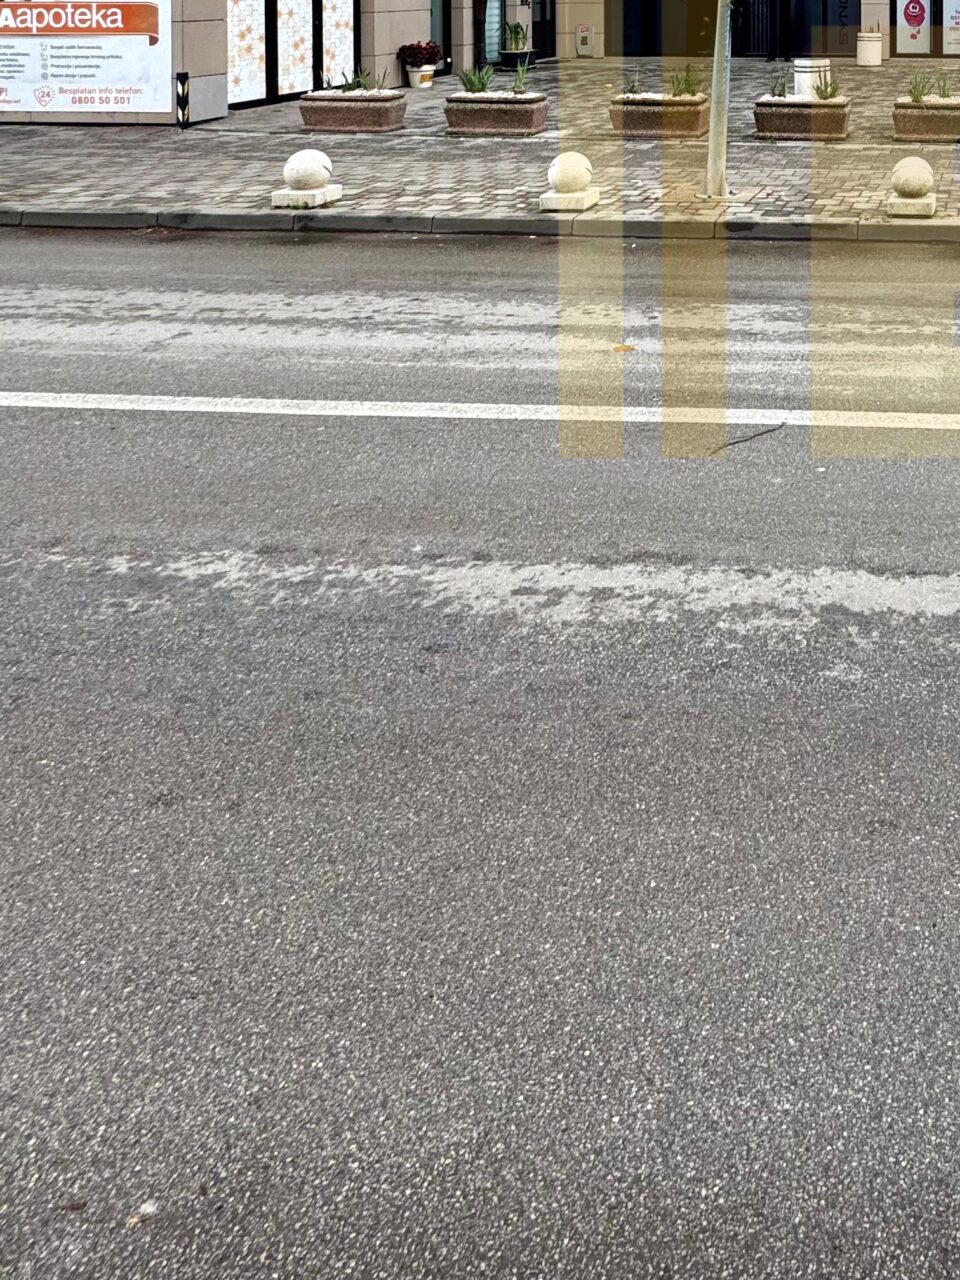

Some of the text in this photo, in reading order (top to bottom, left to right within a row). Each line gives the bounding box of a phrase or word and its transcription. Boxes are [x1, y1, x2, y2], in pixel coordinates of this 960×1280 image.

[40, 90, 51, 99] 24
[58, 86, 97, 96] Besplatan
[98, 86, 114, 95] info
[71, 96, 131, 105] 0800 50 501
